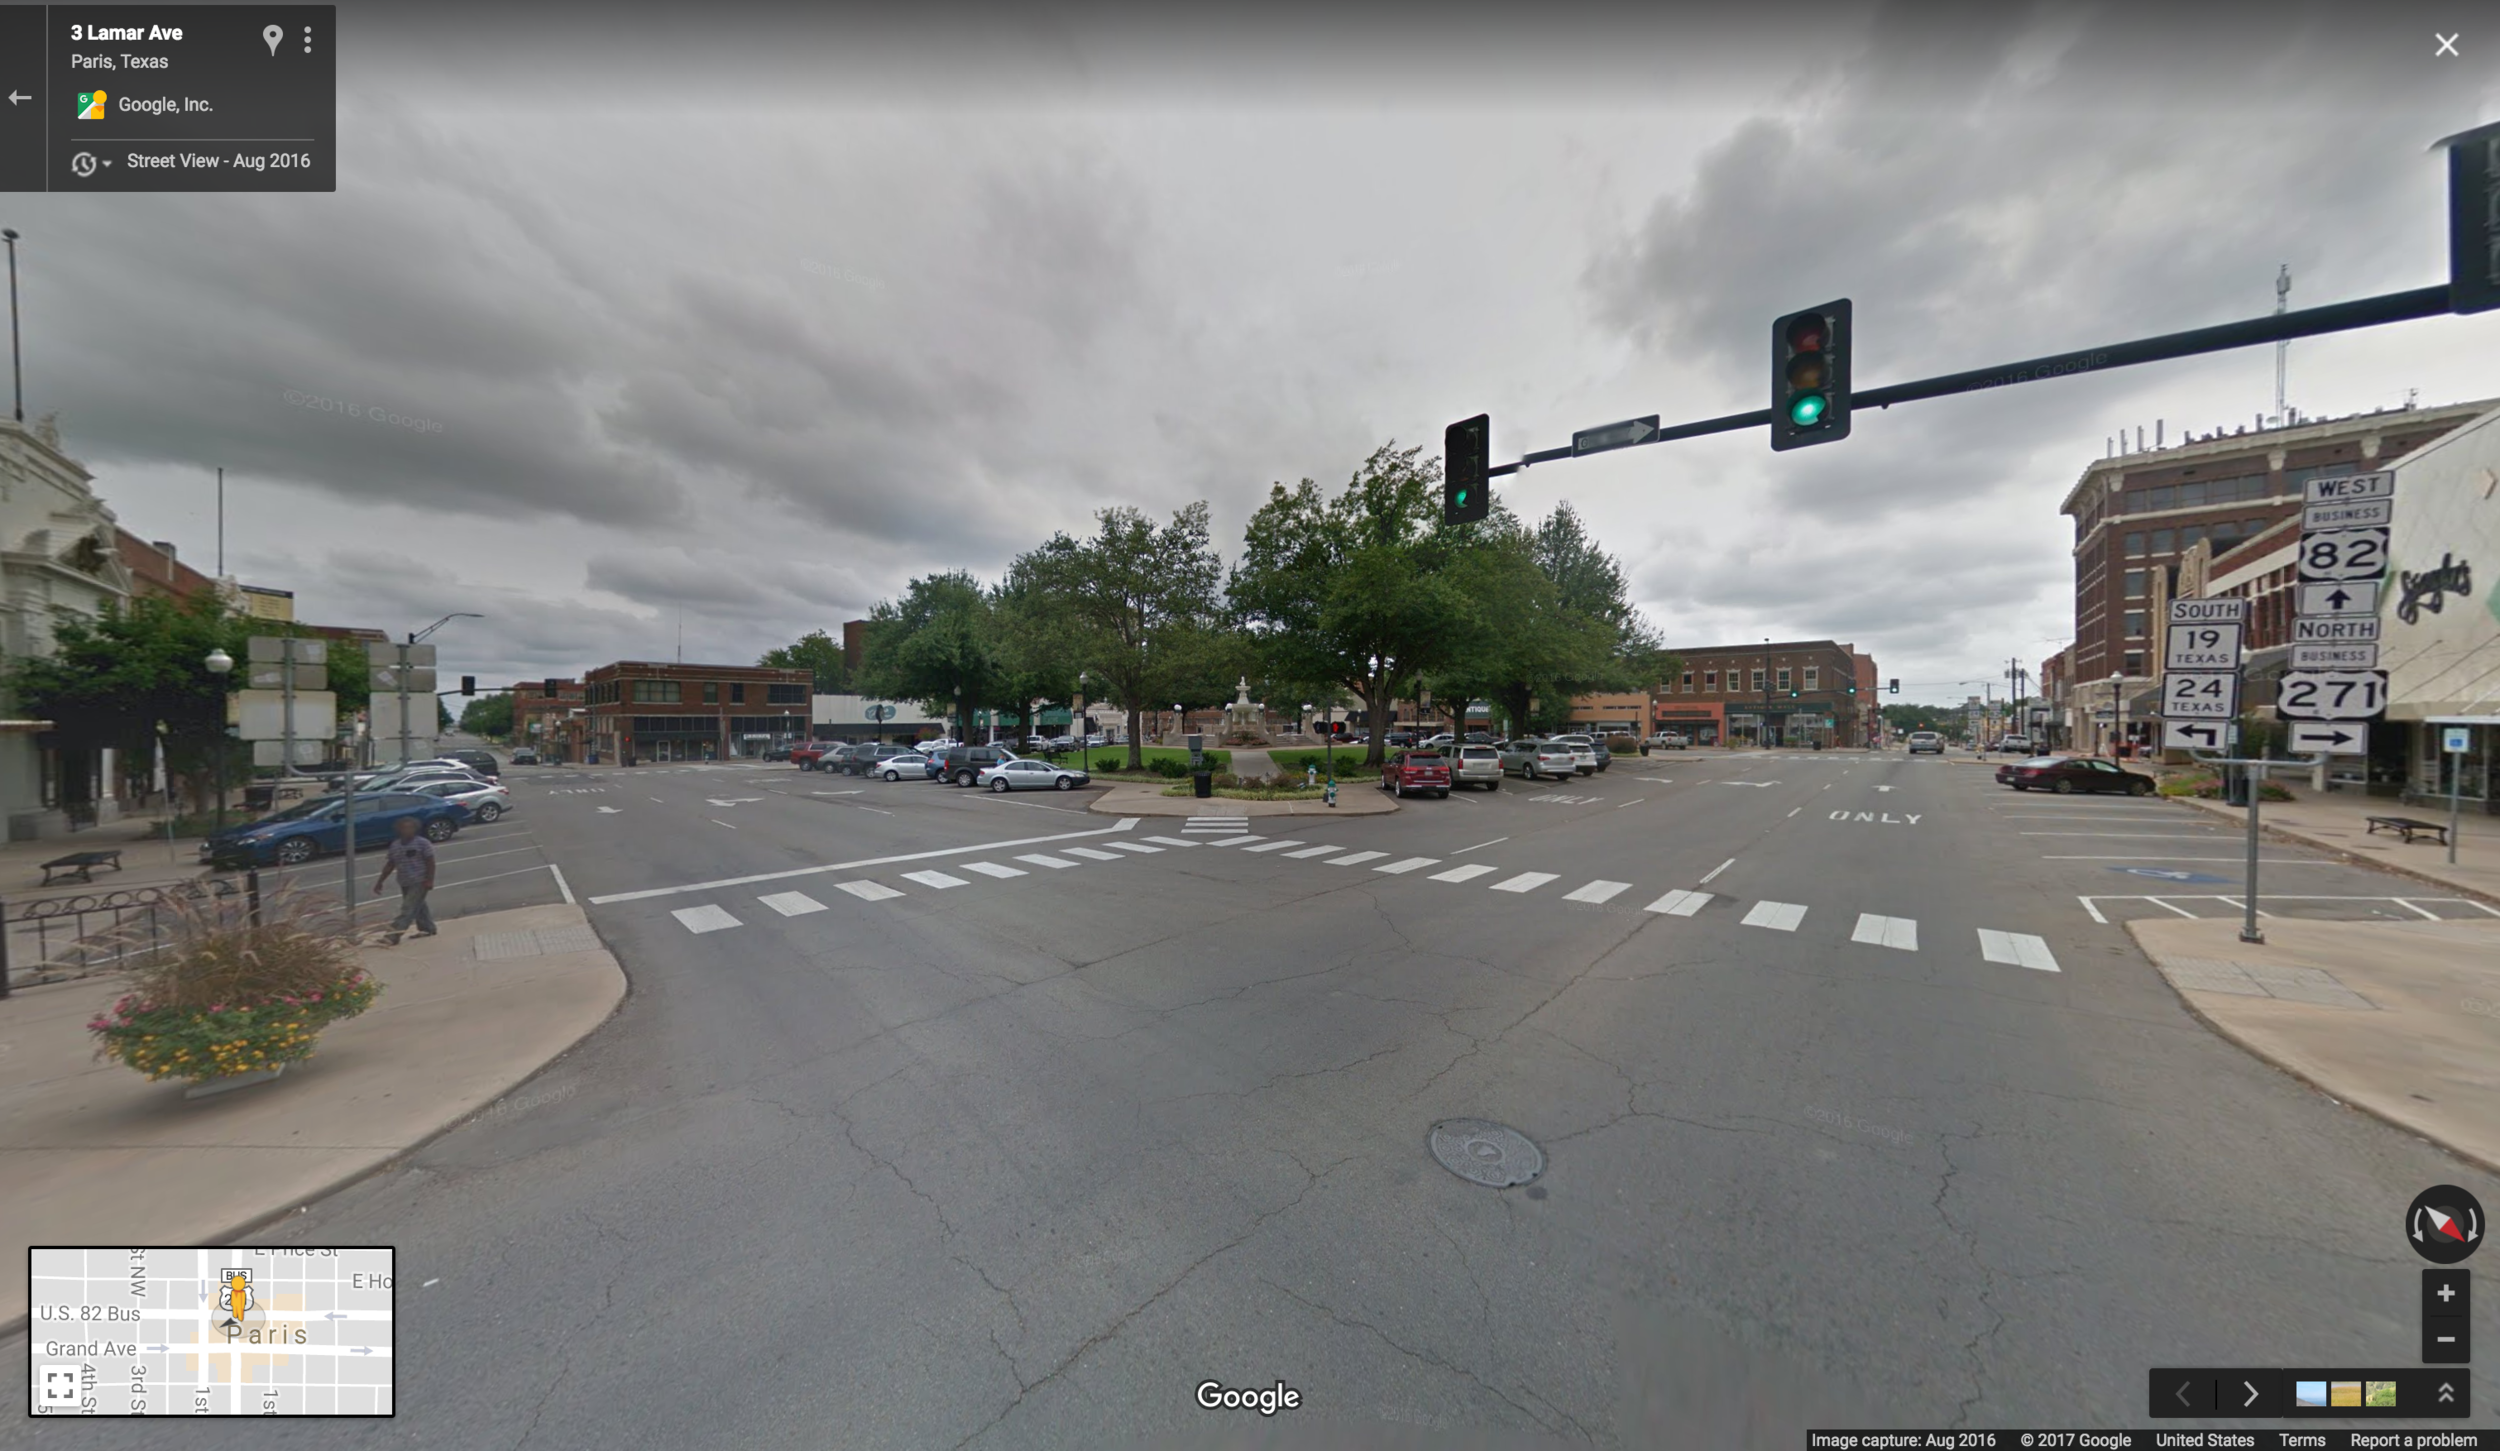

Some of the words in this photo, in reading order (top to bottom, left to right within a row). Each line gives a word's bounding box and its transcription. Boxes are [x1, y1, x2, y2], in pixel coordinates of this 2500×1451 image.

[2318, 477, 2380, 497] WEST
[2312, 507, 2380, 523] BUSINESS
[2308, 540, 2379, 569] 82
[2174, 602, 2239, 619] SOUTH
[2299, 622, 2374, 639] NORTH
[2187, 630, 2220, 649] 19
[2176, 653, 2229, 664] TEXAS
[2301, 650, 2366, 662] BUSINESS
[2175, 679, 2222, 698] 24
[2287, 681, 2377, 709] 271
[2172, 702, 2224, 713] TEXAS
[1828, 810, 1922, 824] ONLY
